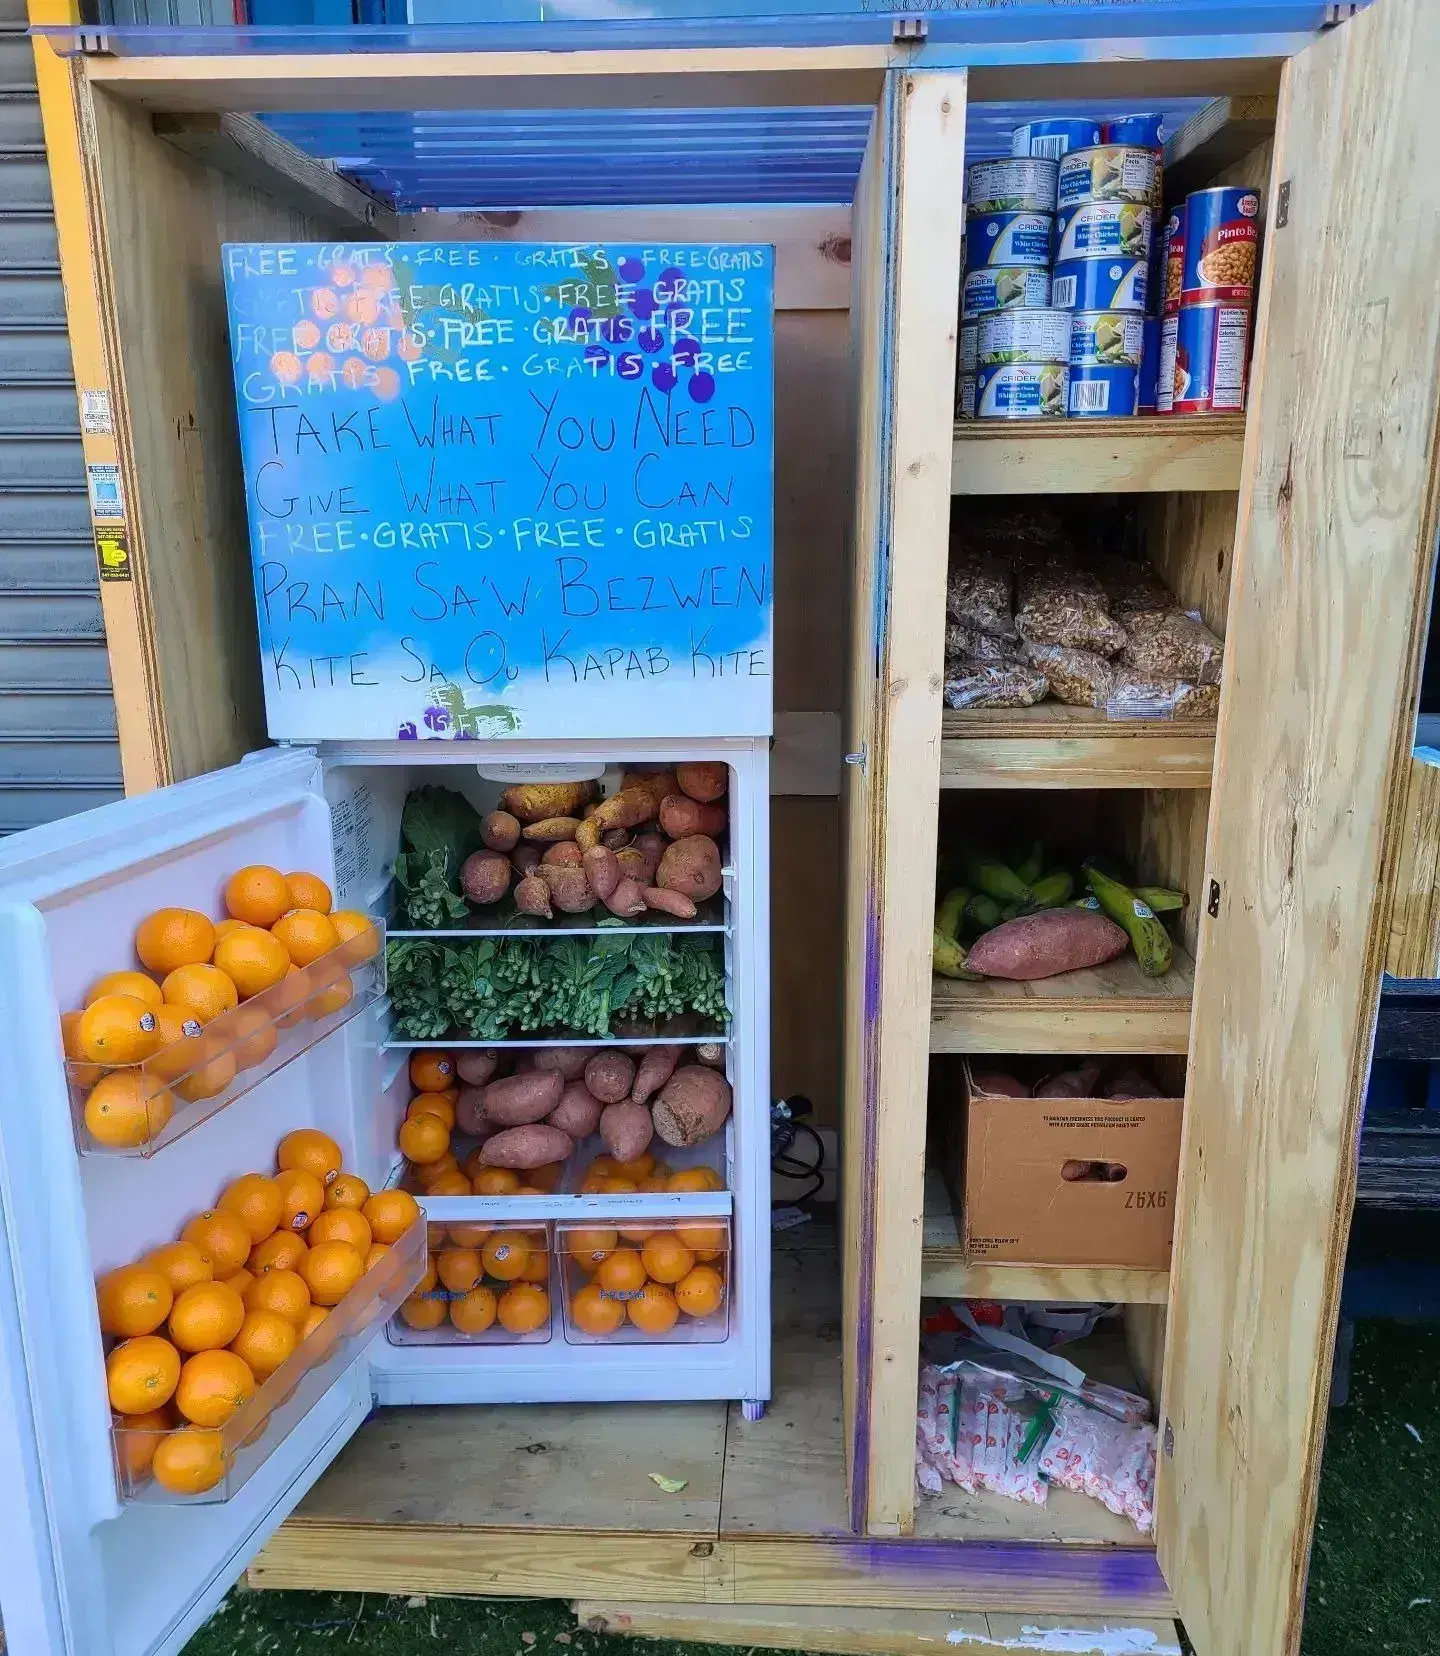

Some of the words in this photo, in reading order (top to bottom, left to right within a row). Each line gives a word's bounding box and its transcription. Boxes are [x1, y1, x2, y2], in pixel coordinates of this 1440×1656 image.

[1061, 161, 1088, 174] CRIDER
[1018, 223, 1048, 232] CRIDER
[1080, 213, 1116, 223] CRIDER
[1217, 226, 1246, 241] Pinto
[228, 249, 298, 282] FREE
[414, 248, 482, 266] FREE
[514, 244, 609, 270] GRATIS
[640, 249, 704, 267] FREE
[438, 283, 542, 314] GRATIS
[558, 283, 637, 310] FREE
[652, 277, 746, 306] GRATIS
[438, 316, 515, 350] FREE
[532, 315, 635, 346] GRATIS
[650, 308, 754, 345] FREE
[406, 357, 496, 387] FREE
[522, 353, 642, 380] GRATIS
[669, 351, 753, 378] FREE
[246, 405, 394, 456] TAKE
[401, 394, 503, 451] WHAT
[528, 388, 616, 452] YOU
[632, 386, 757, 450] NEED
[255, 460, 371, 519] GIVE
[395, 456, 506, 517] WHAT
[528, 453, 608, 512] YOU
[633, 453, 735, 509] CAN
[257, 520, 356, 556] FREE
[372, 519, 495, 550] GRATIS
[512, 517, 606, 552] FREE
[633, 515, 754, 549] GRATIS
[259, 561, 384, 625] PRAN
[554, 555, 771, 619] BEZWEN
[269, 635, 381, 692] KITE
[542, 627, 671, 683] KAPAB
[688, 624, 771, 680] KITE
[421, 1291, 468, 1300] FRESH
[600, 1289, 648, 1300] FRESH
